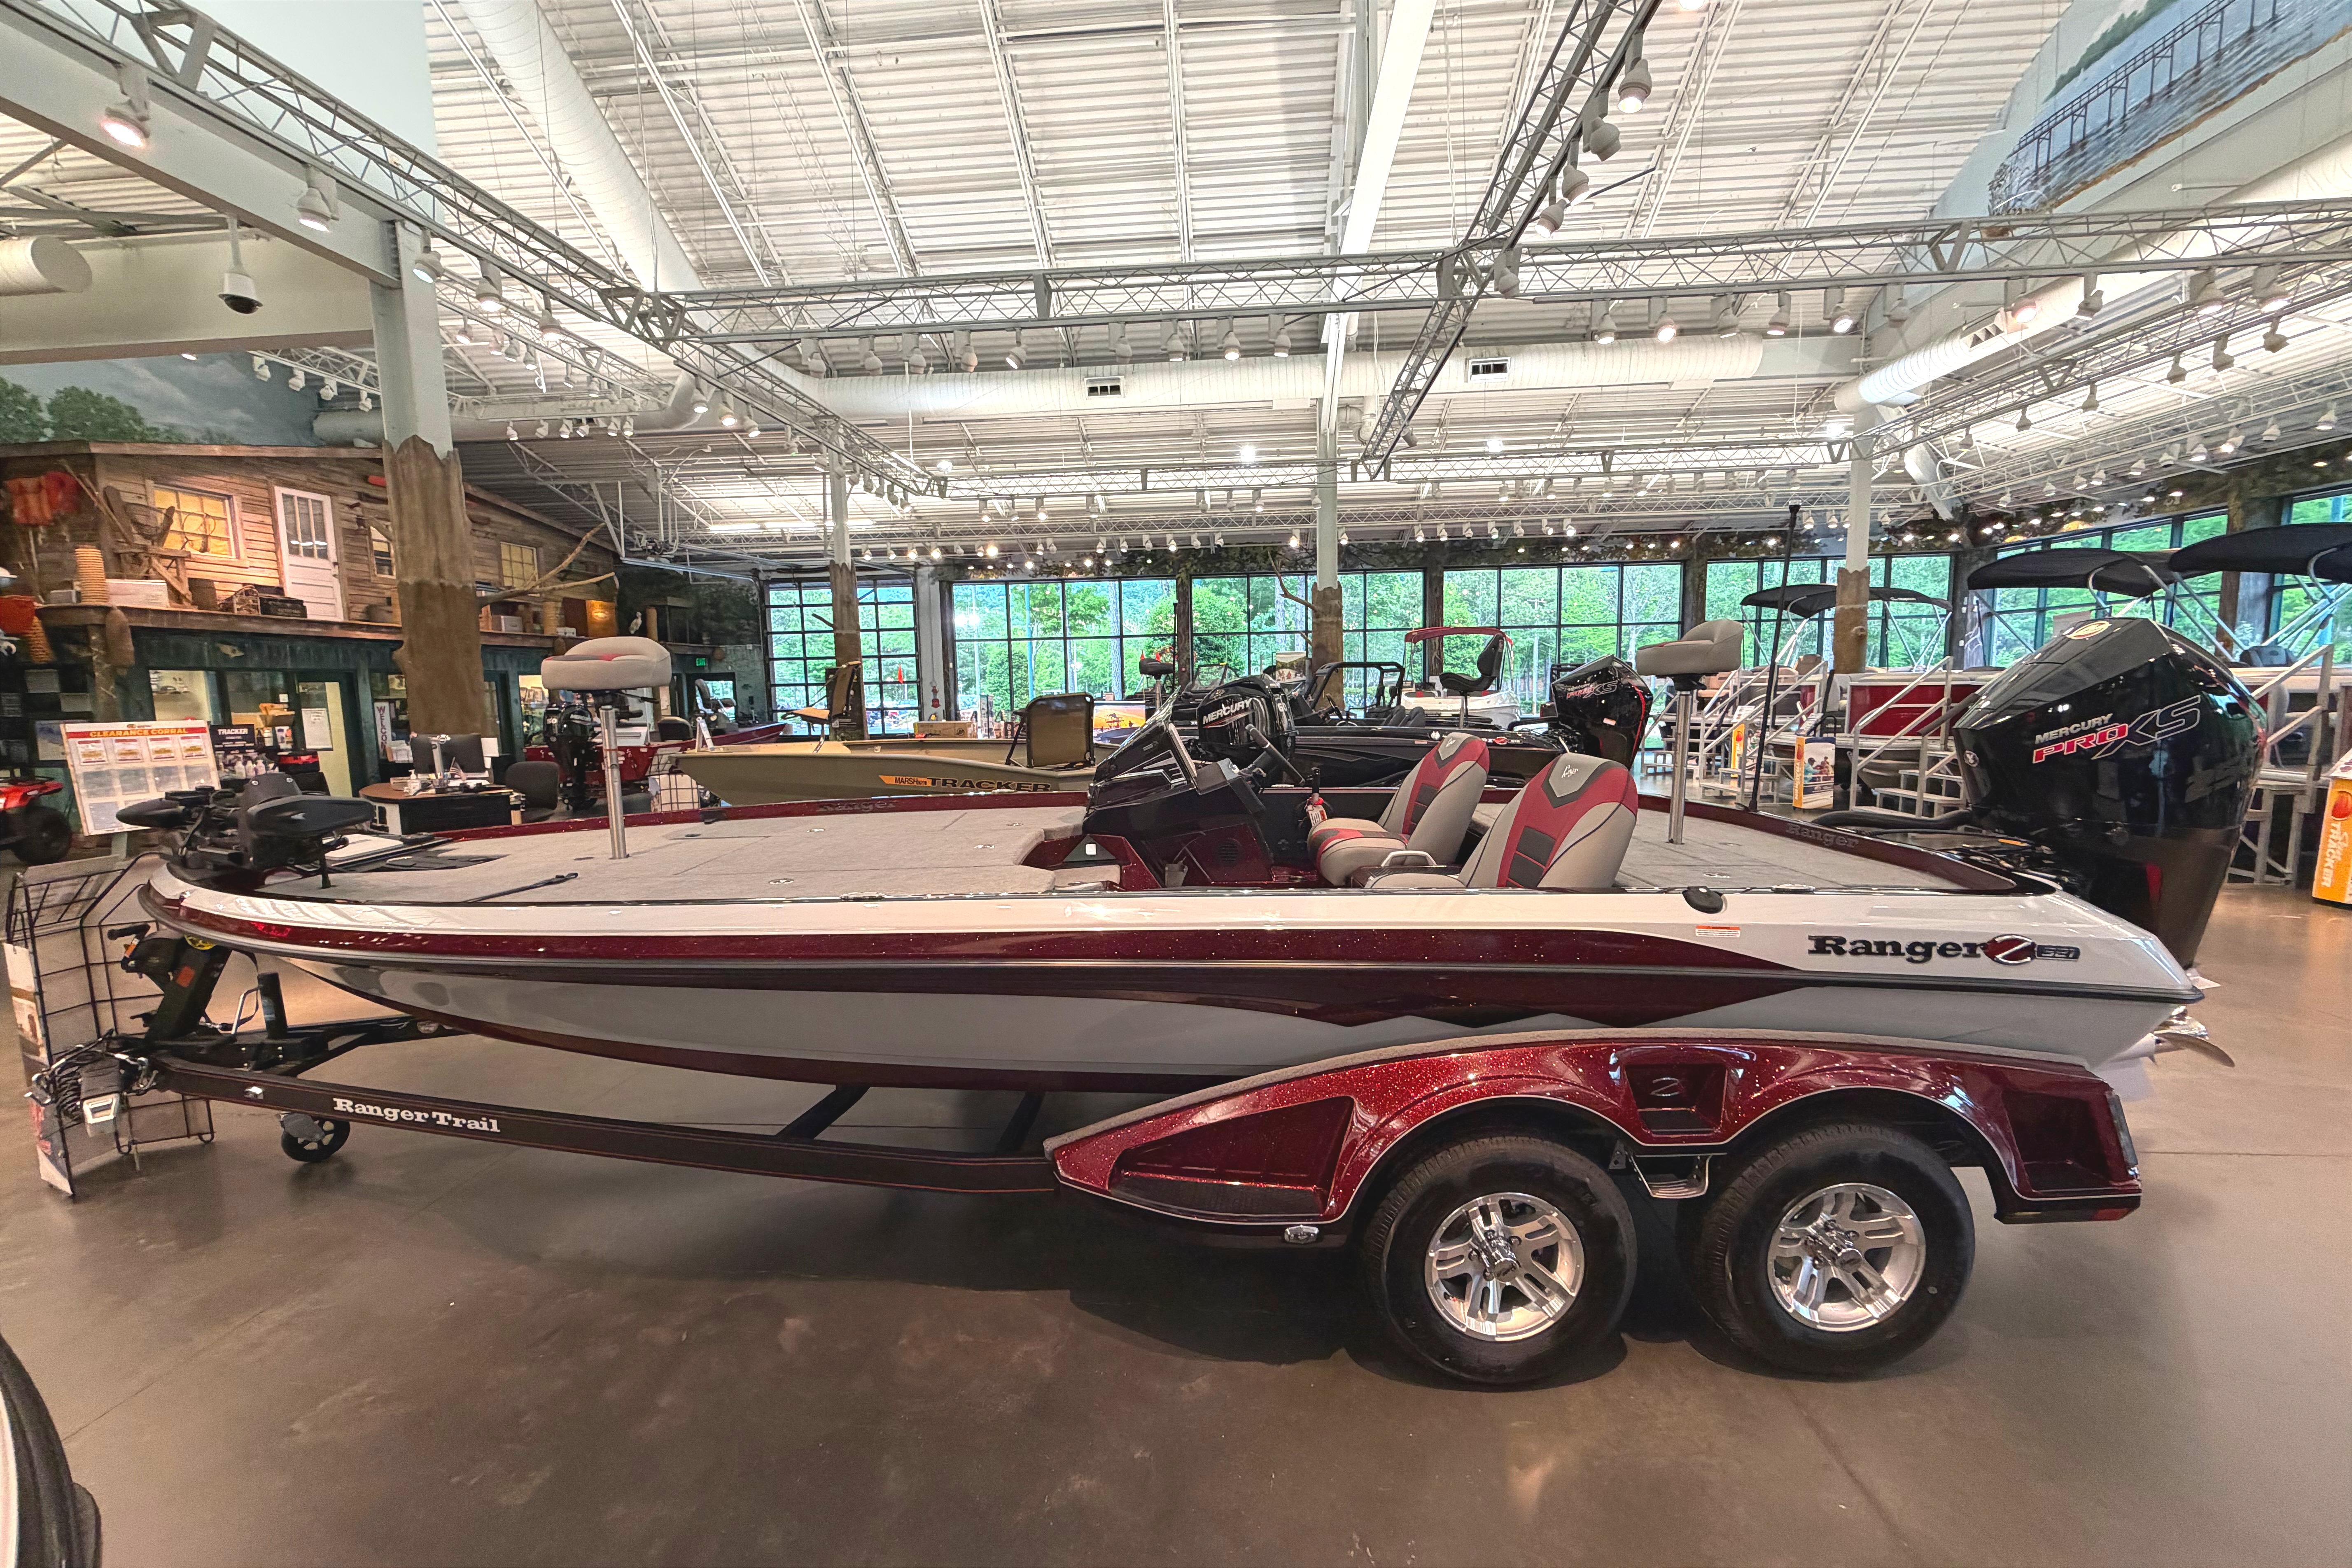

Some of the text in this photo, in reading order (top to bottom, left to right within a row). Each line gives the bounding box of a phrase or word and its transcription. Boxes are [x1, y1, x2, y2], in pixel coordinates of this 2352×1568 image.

[1203, 698, 1253, 724] MERCURY
[89, 729, 149, 737] CLEARANCE
[2035, 713, 2114, 744] MERCURY
[927, 777, 1051, 793] TRACKER
[1785, 824, 1859, 848] Ranger
[2321, 823, 2342, 888] TRACKER
[1808, 935, 1988, 964] Ranger
[333, 1098, 501, 1133] Ranger Trail
